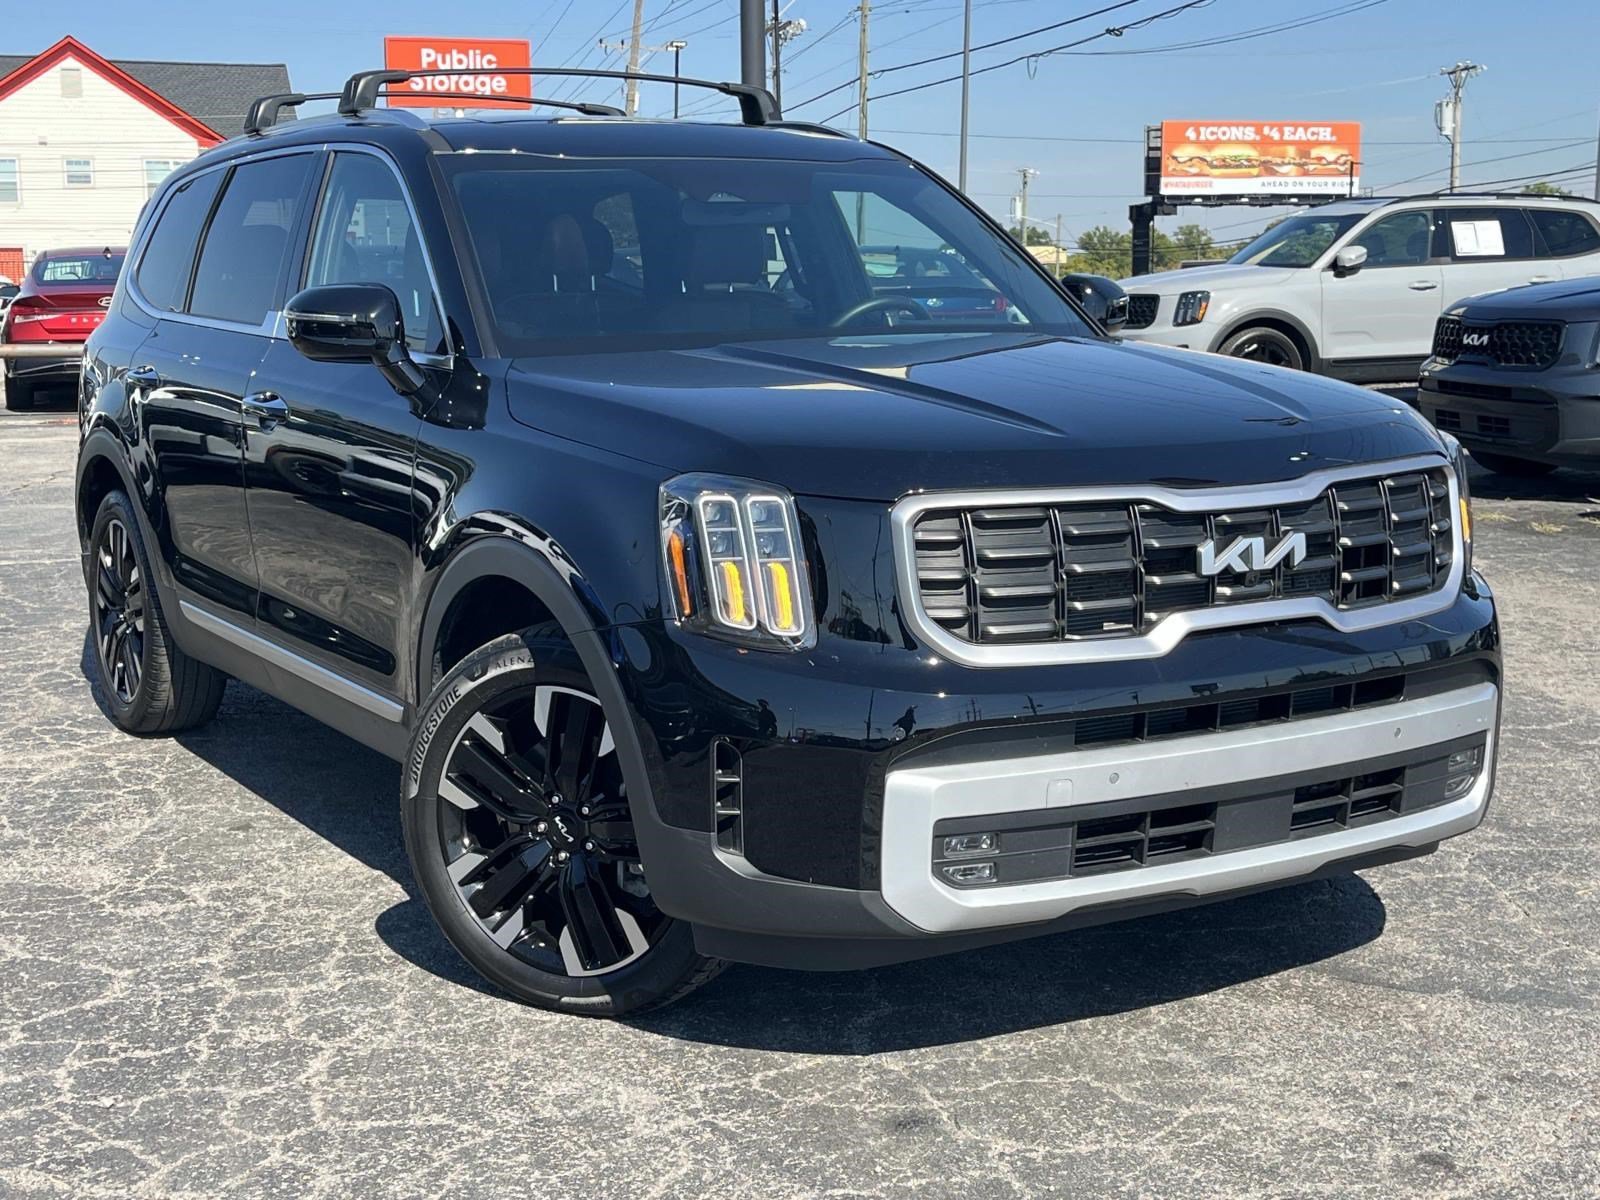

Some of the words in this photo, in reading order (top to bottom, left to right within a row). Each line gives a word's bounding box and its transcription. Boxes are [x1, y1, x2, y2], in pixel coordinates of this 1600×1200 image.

[420, 48, 497, 69] Public
[410, 73, 507, 95] Storage
[1185, 126, 1197, 141] 4
[1199, 126, 1260, 141] ICONS.
[1263, 126, 1281, 141] $4
[1283, 126, 1336, 141] EACH.
[1197, 530, 1307, 577] KIA
[409, 685, 462, 786] BRIDGESTONE
